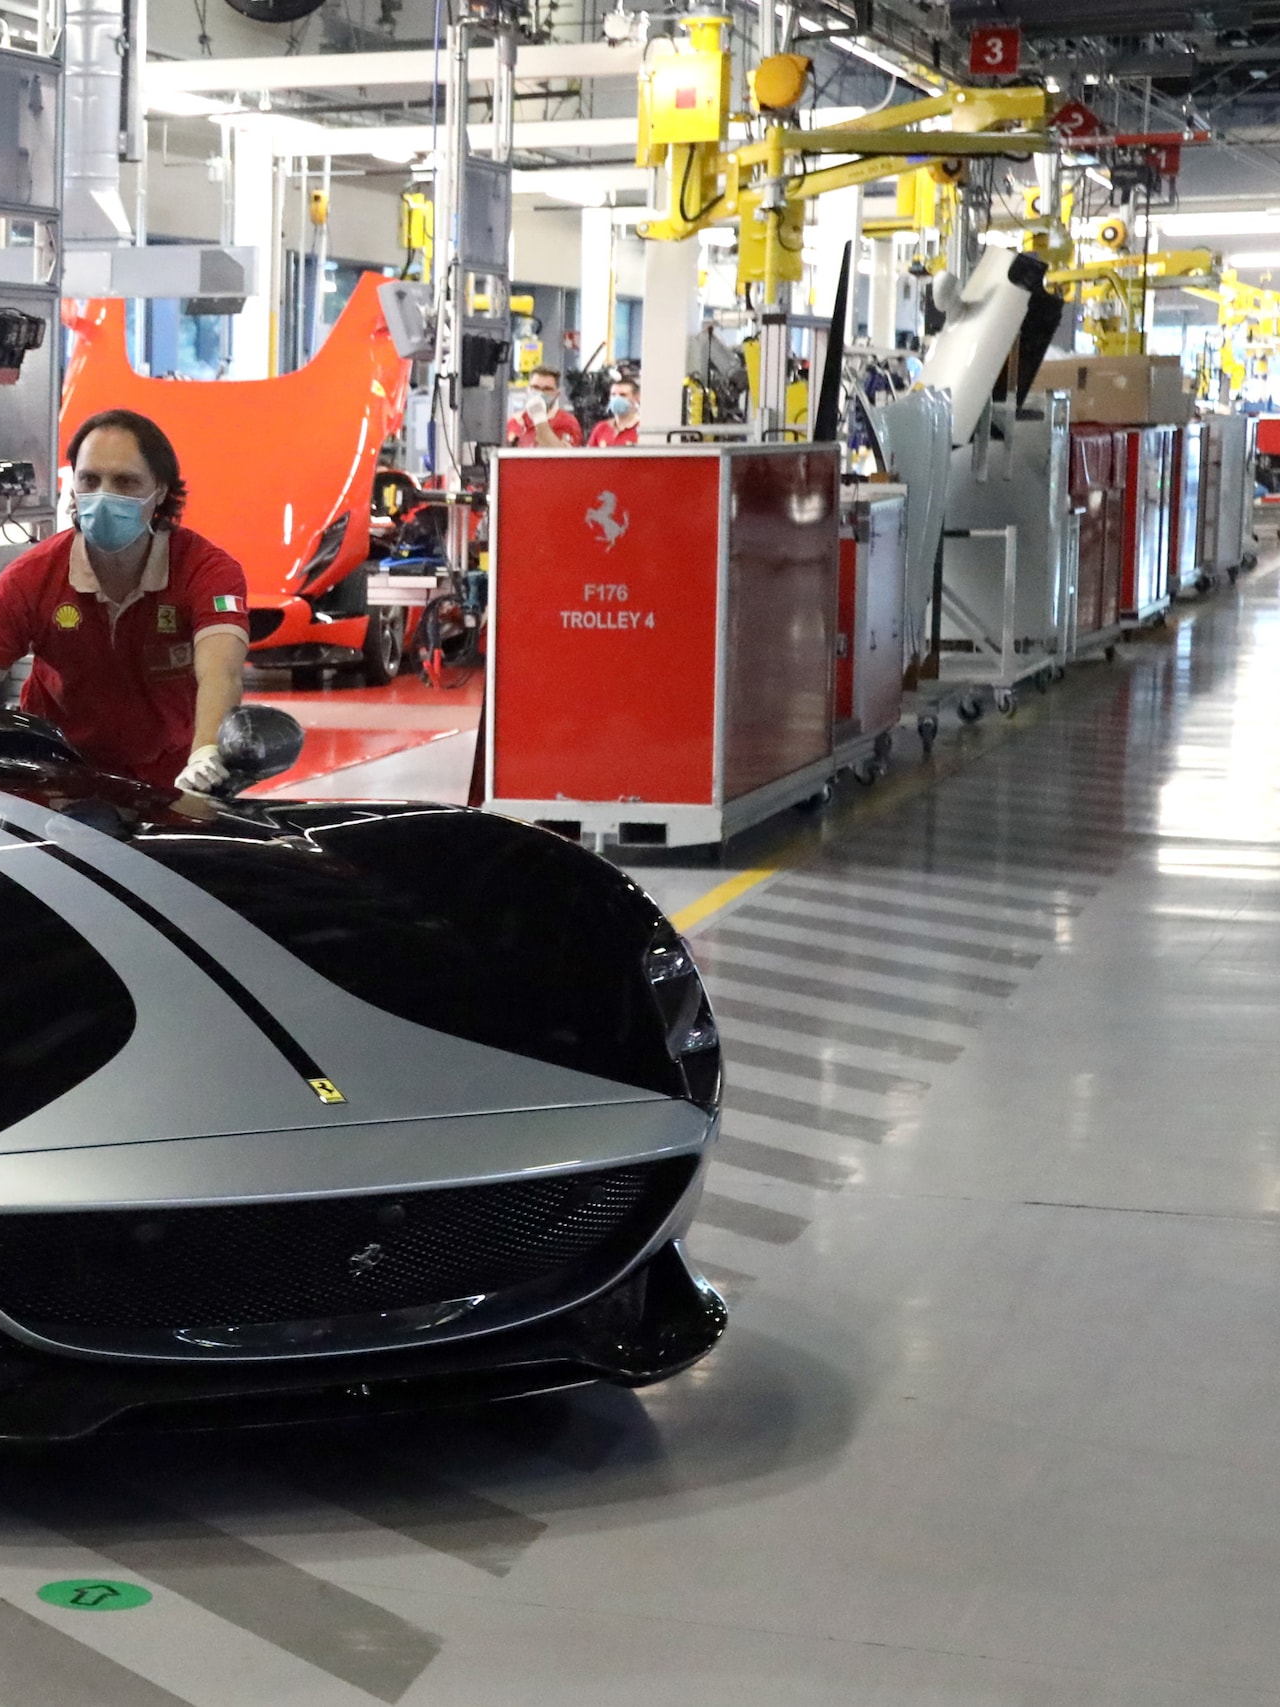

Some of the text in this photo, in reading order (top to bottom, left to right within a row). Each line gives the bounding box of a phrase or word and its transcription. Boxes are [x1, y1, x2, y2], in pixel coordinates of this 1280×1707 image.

[984, 37, 1004, 65] 3
[1060, 113, 1084, 136] 2
[1156, 150, 1167, 169] 1
[583, 584, 629, 601] F176
[560, 611, 655, 629] TROLLEY 4
